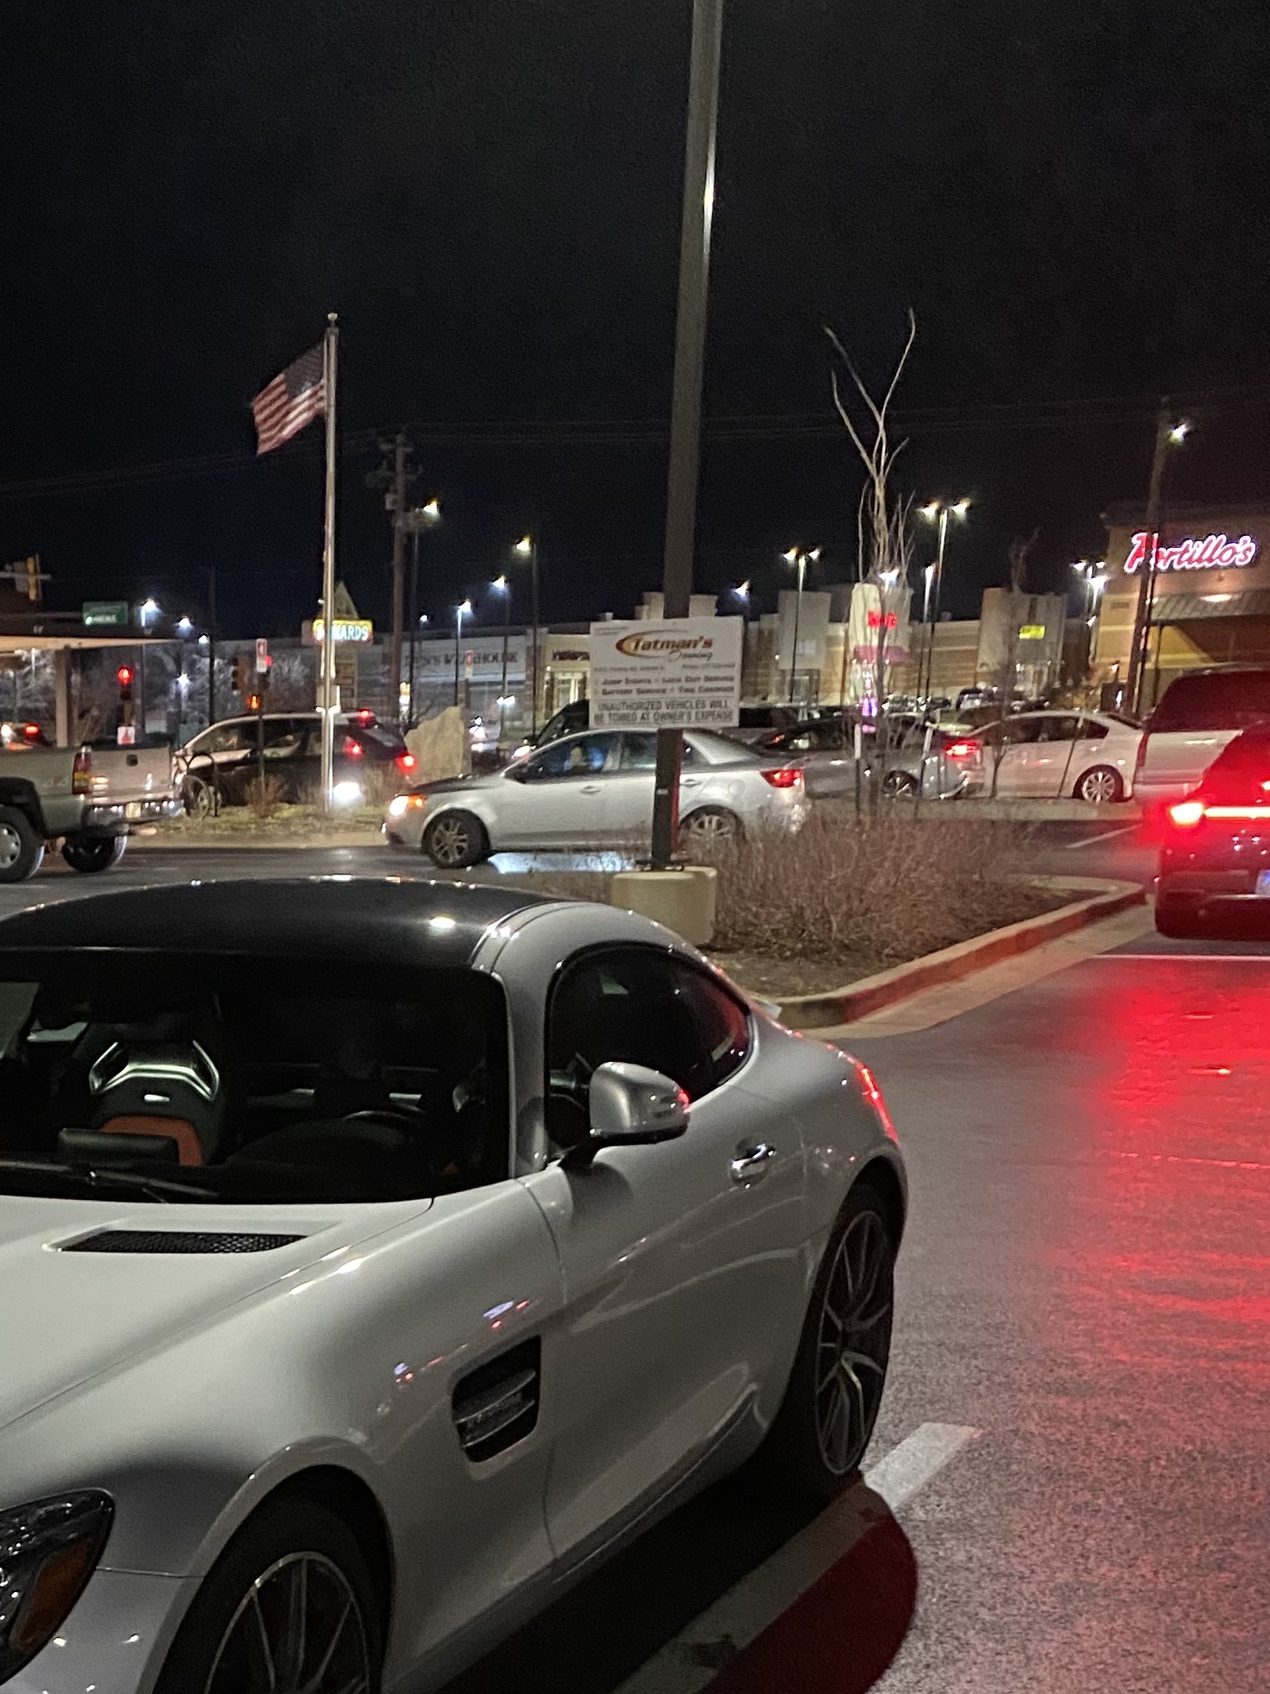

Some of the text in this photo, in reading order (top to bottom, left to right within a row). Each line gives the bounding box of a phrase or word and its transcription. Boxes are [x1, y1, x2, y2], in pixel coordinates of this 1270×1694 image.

[598, 699, 730, 712] UNAUTHORIZED VEHICLES WILL
[594, 709, 733, 725] BE TOWED AT OWNER'S EXPENSE
